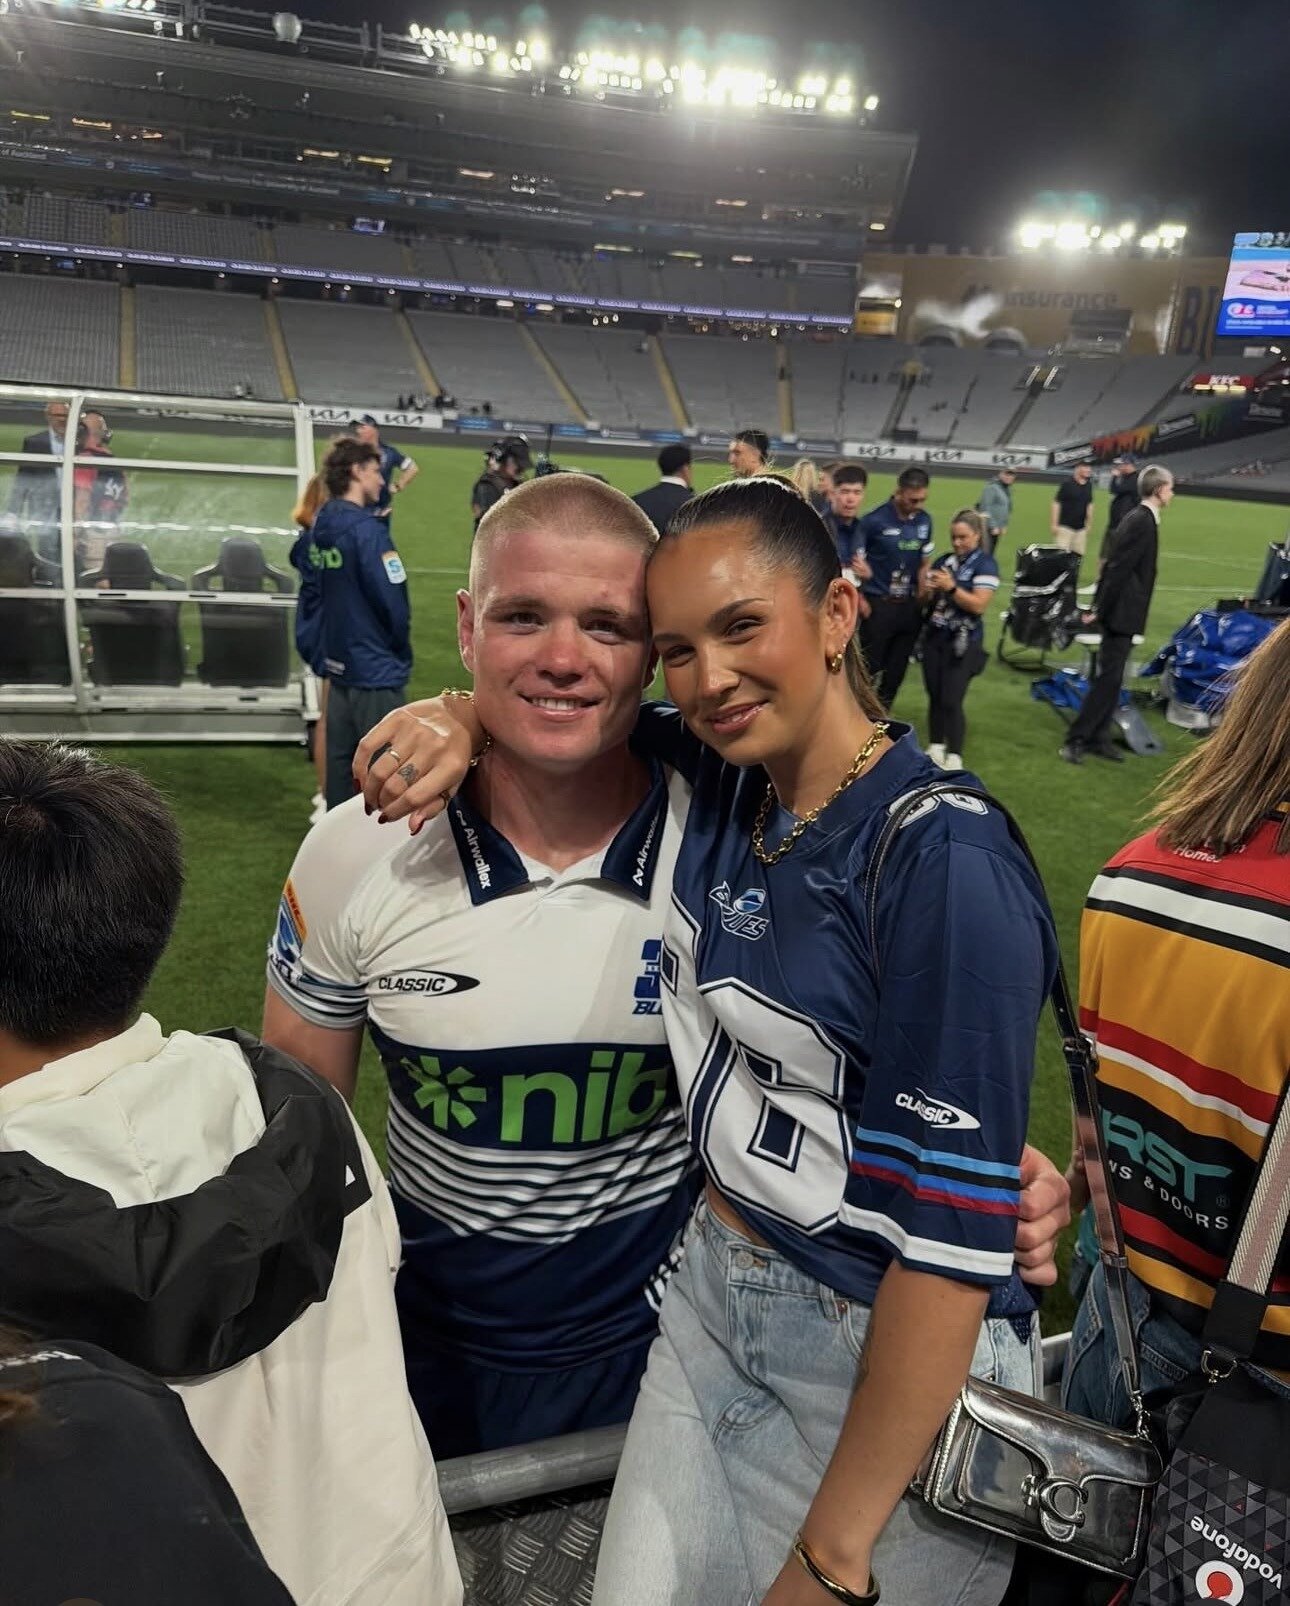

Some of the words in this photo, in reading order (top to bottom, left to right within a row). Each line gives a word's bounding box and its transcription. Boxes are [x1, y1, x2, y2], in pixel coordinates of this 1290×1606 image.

[385, 413, 423, 425] KIA
[464, 826, 492, 890] Airwallex
[378, 977, 446, 992] CLASSIC
[501, 1050, 668, 1143] nib
[895, 1092, 952, 1124] CLASSIC
[1099, 1105, 1233, 1203] RST
[1143, 1176, 1155, 1190] &
[1160, 1187, 1229, 1230] DOORS
[1190, 1515, 1282, 1590] vodafone
